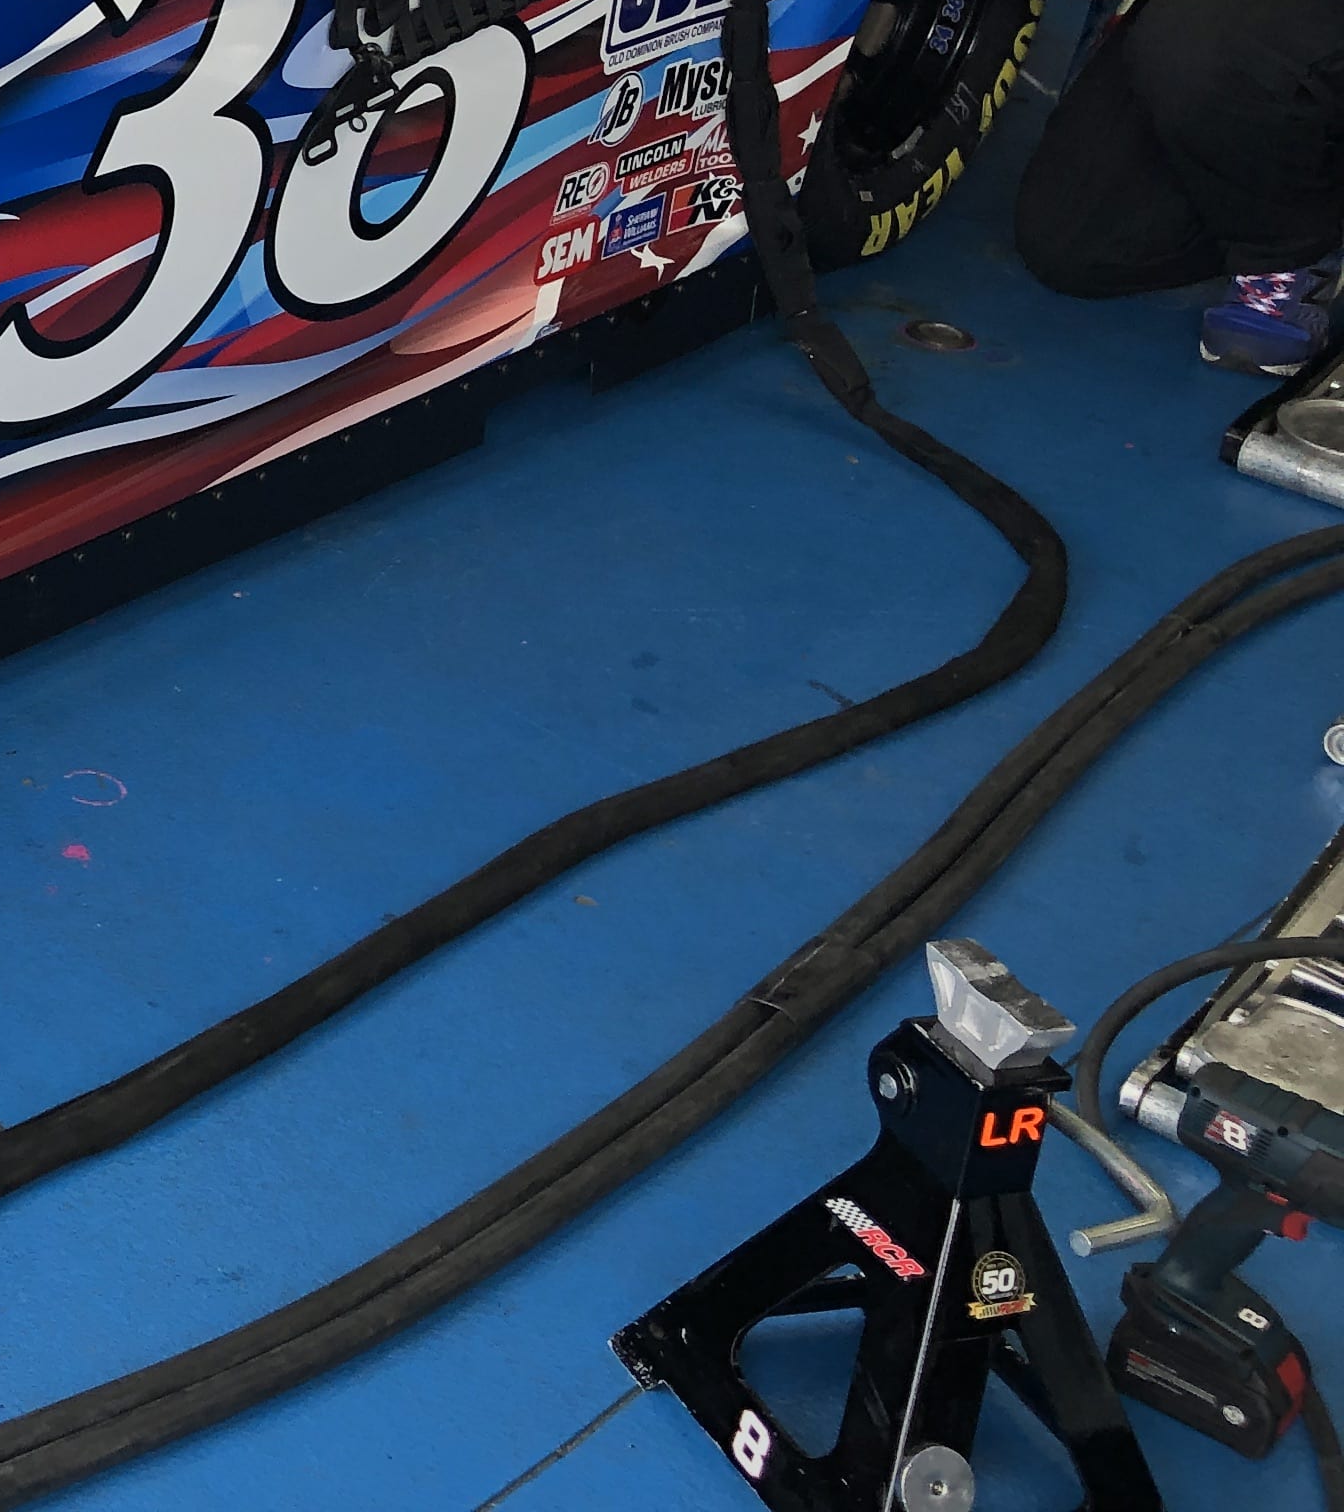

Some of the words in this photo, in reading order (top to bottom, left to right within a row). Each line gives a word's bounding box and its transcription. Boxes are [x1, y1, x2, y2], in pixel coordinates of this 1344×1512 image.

[608, 51, 624, 68] OLD
[624, 39, 663, 62] DOMINION
[663, 28, 691, 49] BRUSH
[690, 17, 725, 38] COMPAN
[618, 137, 684, 176] LINCOLN
[629, 158, 686, 189] WELDERS
[537, 222, 596, 280] SEM
[979, 1105, 1045, 1148] LR
[1222, 1119, 1248, 1152] 8
[855, 1226, 926, 1279] RCR
[981, 1267, 1017, 1295] 50
[1237, 1307, 1270, 1330] 8
[732, 1410, 770, 1480] 8
